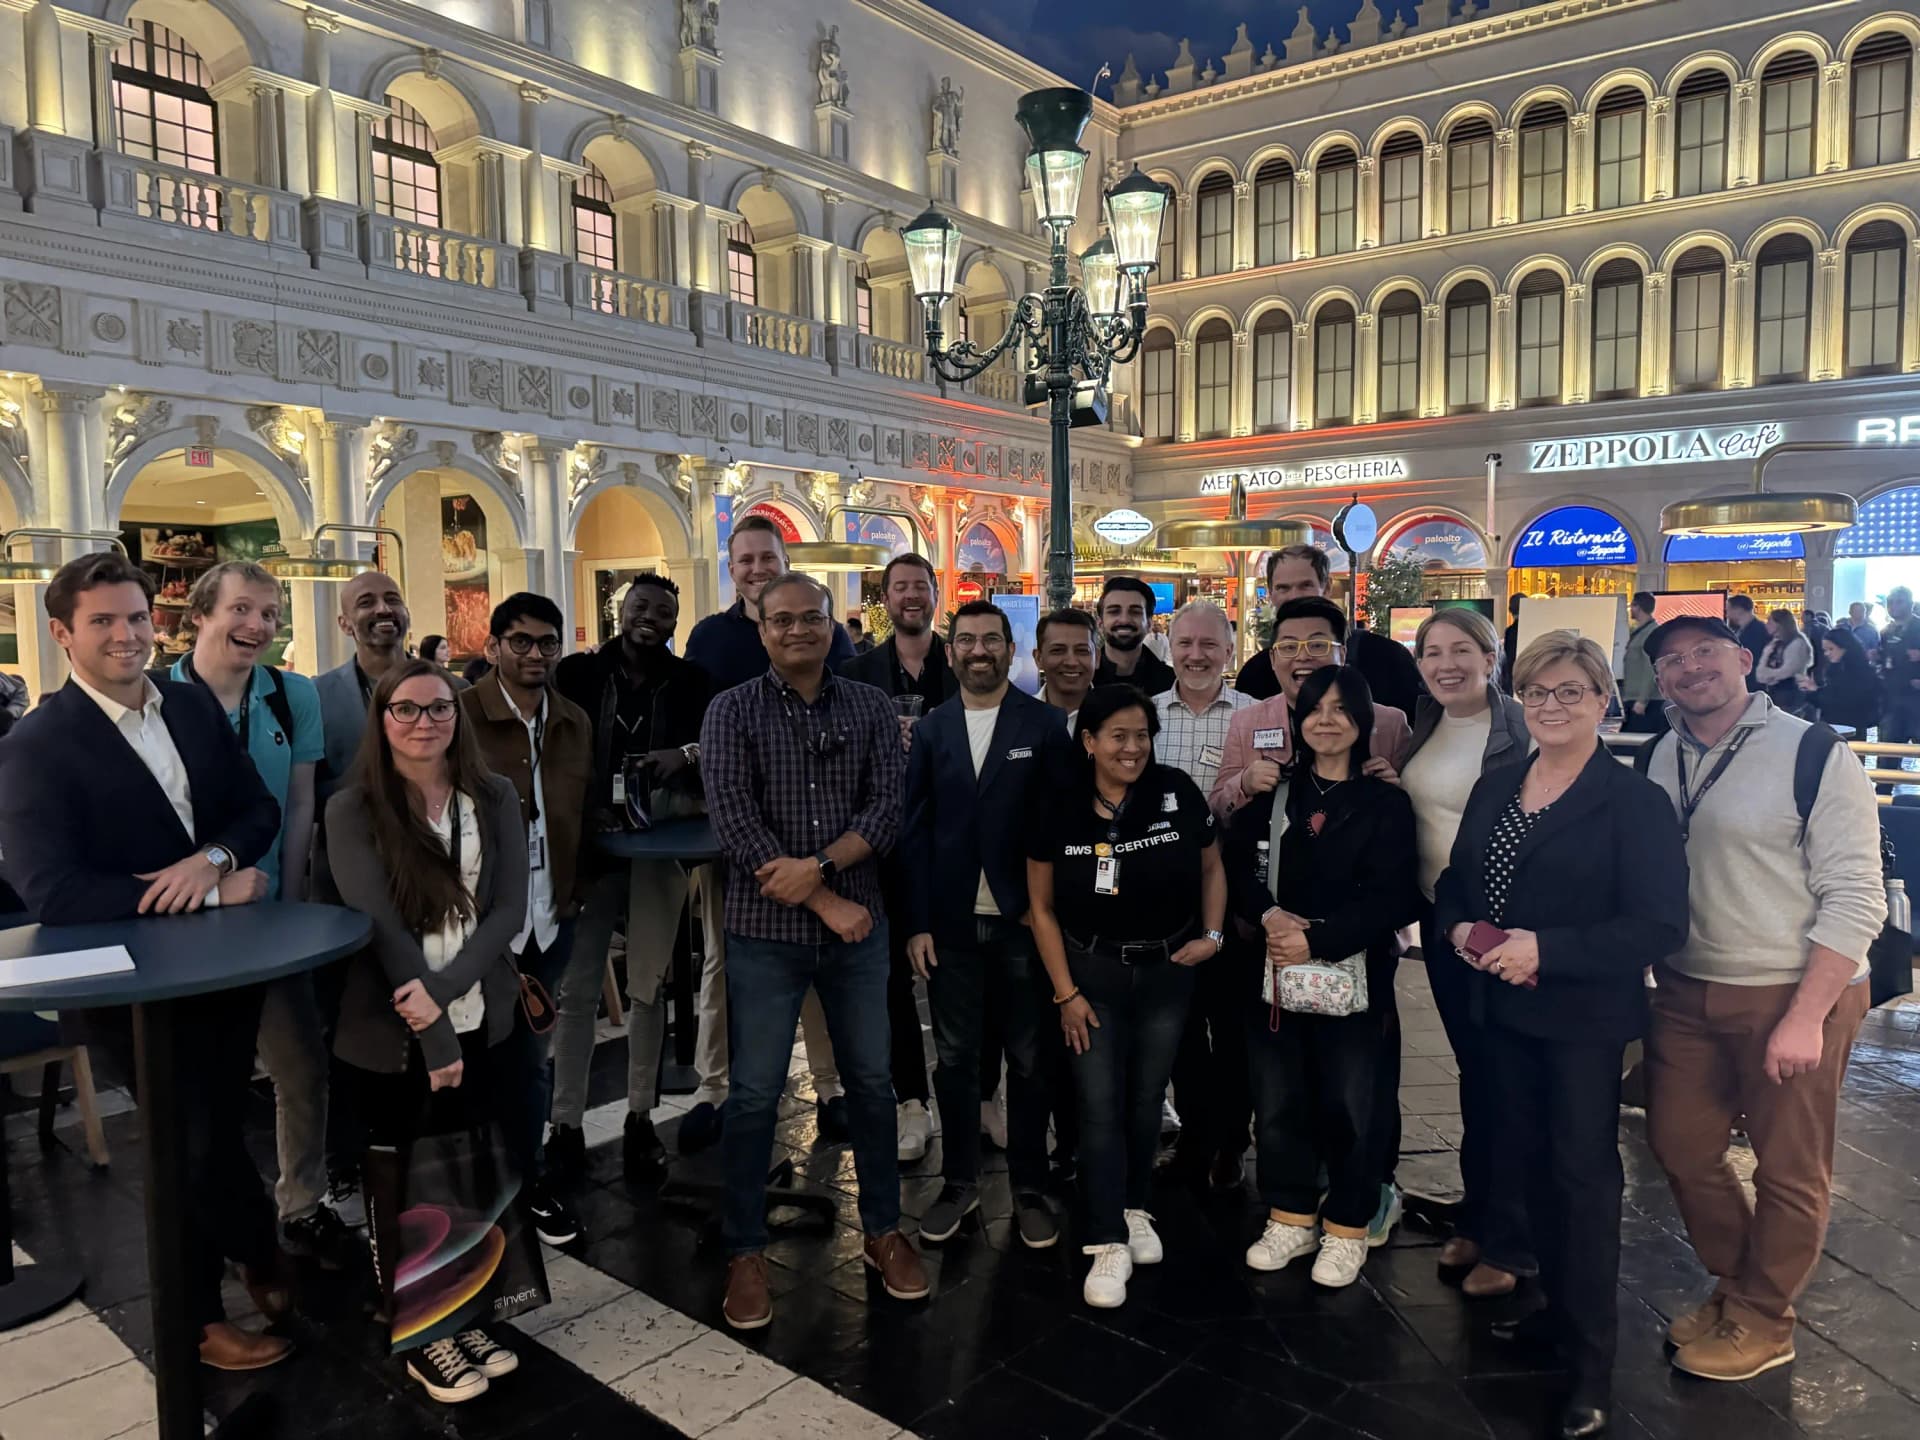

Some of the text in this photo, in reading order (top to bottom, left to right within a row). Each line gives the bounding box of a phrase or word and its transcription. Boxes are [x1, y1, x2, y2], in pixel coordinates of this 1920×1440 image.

[1533, 423, 1780, 469] ZEPPOLA Café
[191, 450, 209, 465] EXIT
[1304, 460, 1403, 483] PESCHERIA
[1424, 534, 1461, 545] paloalto
[1523, 526, 1628, 547] Il Ristorante
[1065, 831, 1180, 856] aws CERTIFIED
